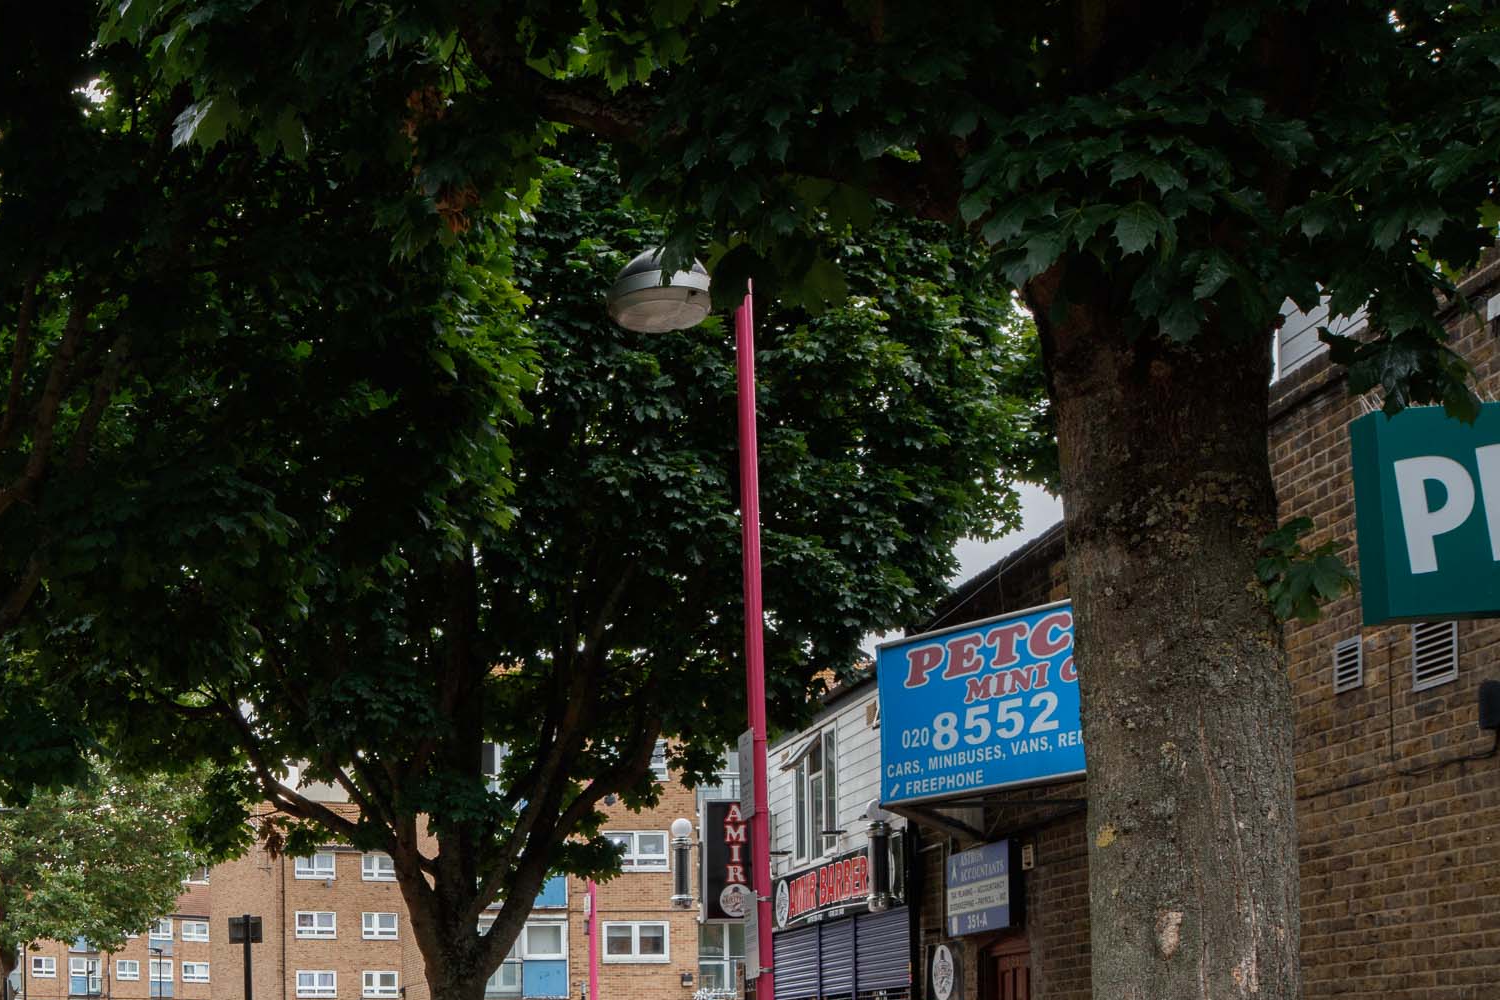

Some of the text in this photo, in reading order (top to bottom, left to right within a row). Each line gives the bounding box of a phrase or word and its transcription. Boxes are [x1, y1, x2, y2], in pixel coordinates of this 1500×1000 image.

[904, 612, 1074, 688] PETC
[964, 662, 1050, 704] MINI
[902, 692, 1059, 751] 020 8552
[887, 761, 924, 778] CARS,
[928, 745, 1007, 771] MINIBUSES,
[1011, 736, 1053, 757] VANS,
[906, 770, 984, 795] FREEPHONE
[724, 804, 747, 883] AMIR
[961, 859, 1005, 881] ACCOUNTANTS
[789, 871, 817, 919] AMIR
